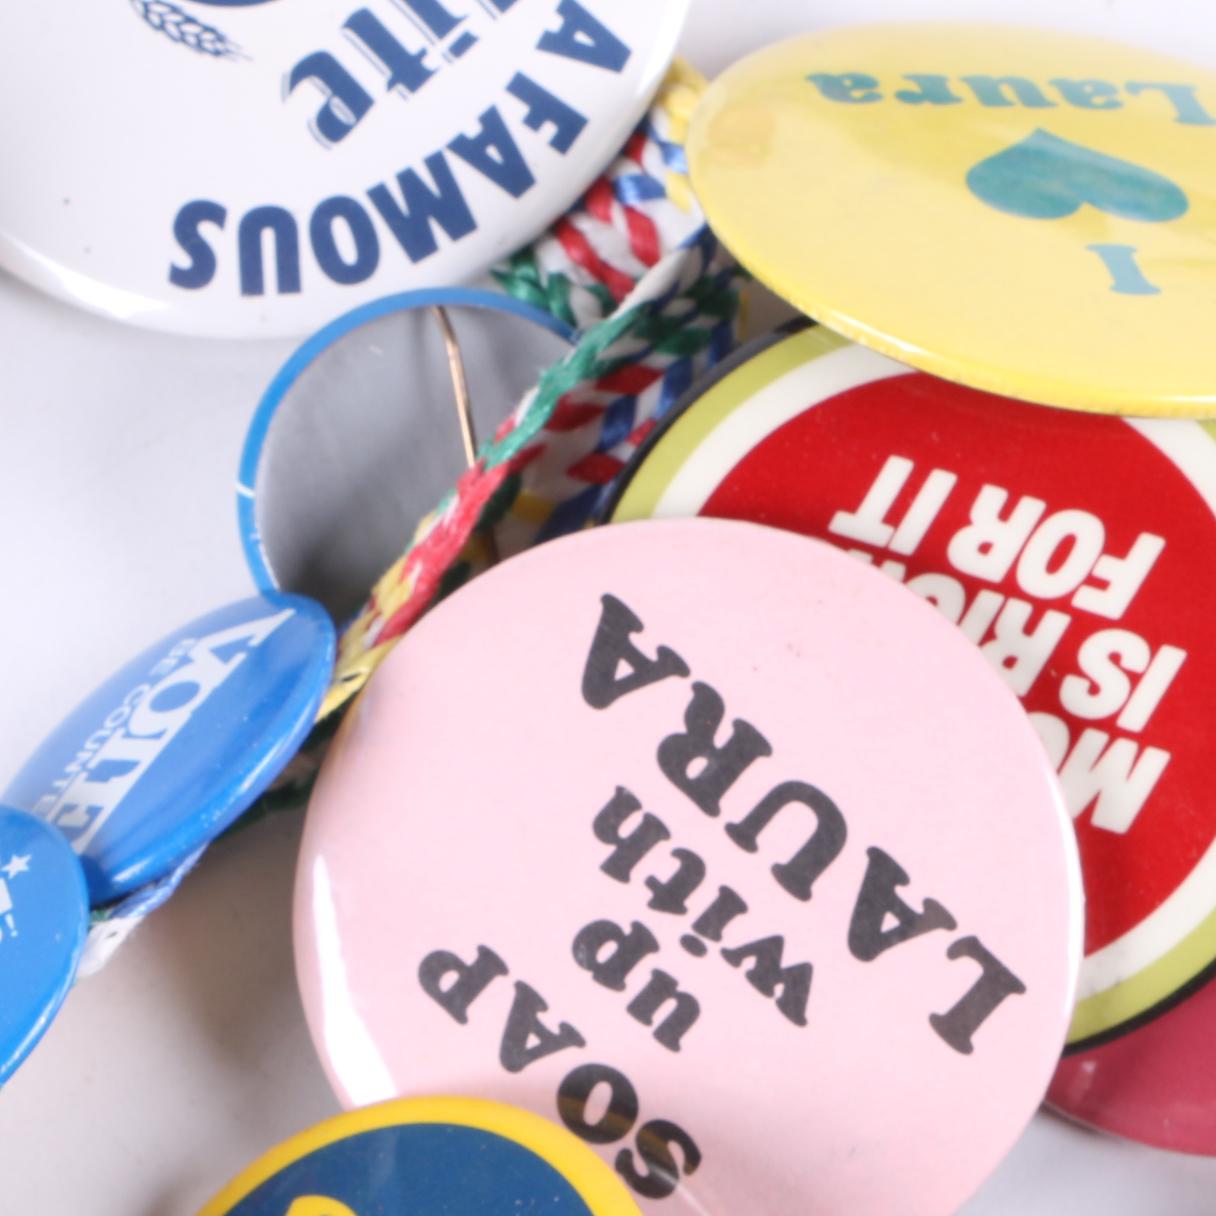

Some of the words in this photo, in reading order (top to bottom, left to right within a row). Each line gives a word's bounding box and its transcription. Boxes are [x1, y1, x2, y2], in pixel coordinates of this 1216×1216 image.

[535, 0, 632, 74] A
[168, 70, 589, 297] FAMOUS
[1086, 243, 1161, 296] I
[827, 454, 957, 556] IT
[946, 483, 1166, 621] FOR
[1058, 627, 1188, 733] IS
[580, 592, 1027, 1056] LAURA
[591, 784, 814, 1028] with
[571, 917, 702, 1053] up
[417, 942, 703, 1200] SOAP
